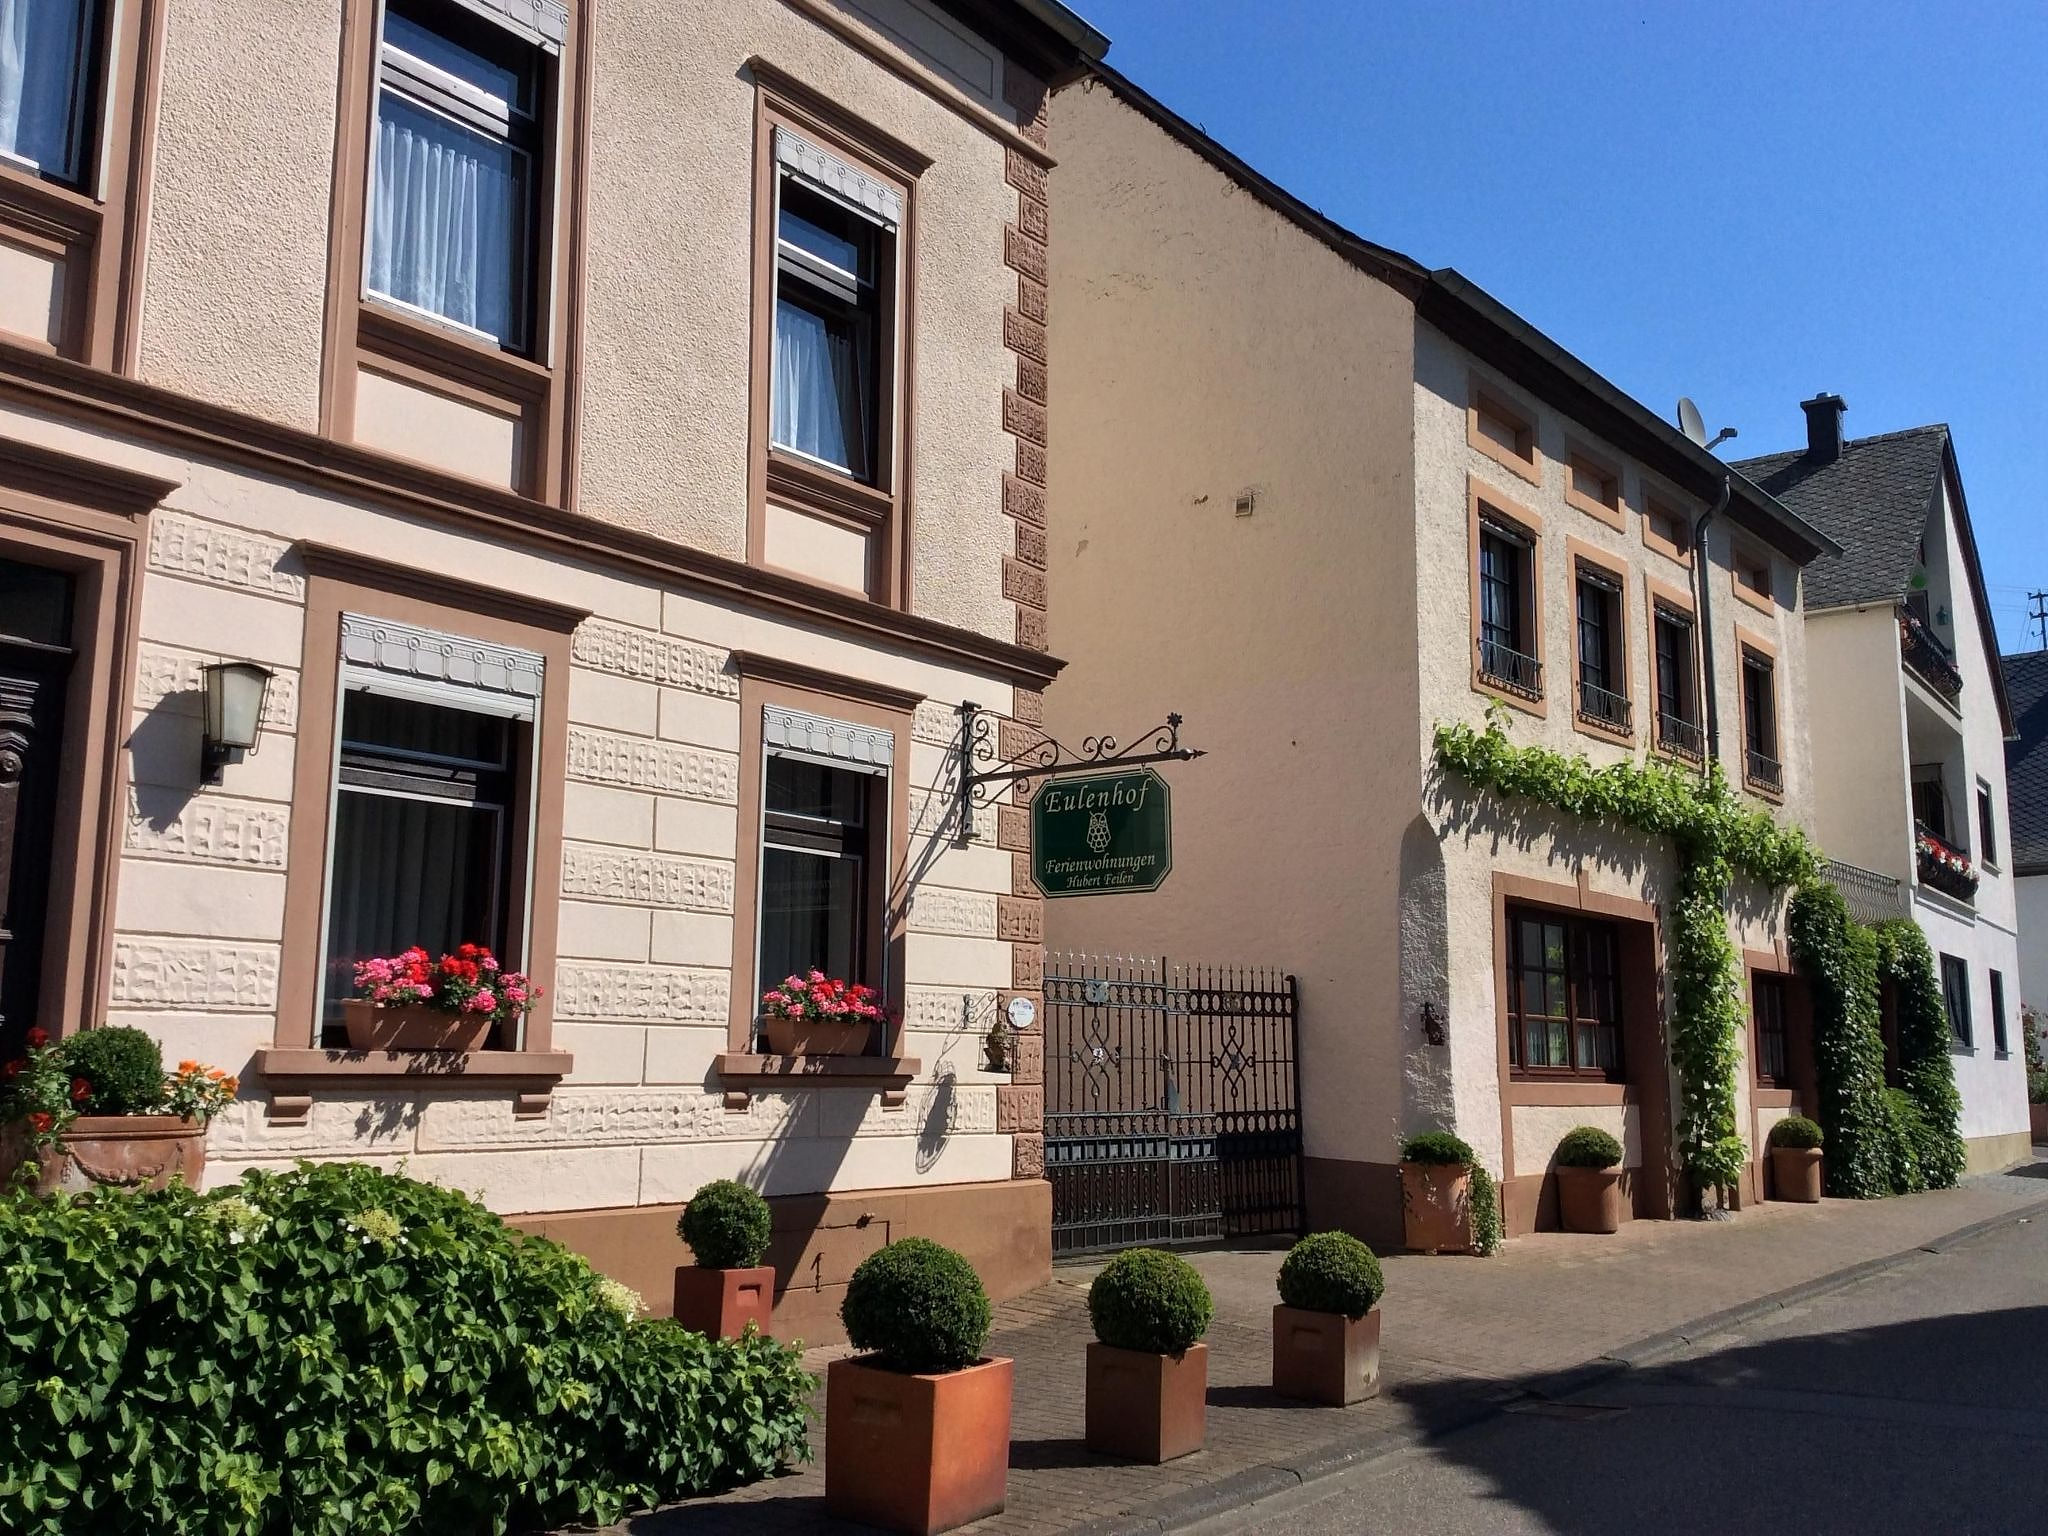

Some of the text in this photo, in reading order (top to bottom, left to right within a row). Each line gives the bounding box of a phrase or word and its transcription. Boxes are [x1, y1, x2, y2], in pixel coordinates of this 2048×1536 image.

[1044, 778, 1152, 813] Eulenhof
[1045, 852, 1156, 874] Ferienwohnungen
[1066, 870, 1135, 888] Hubert Feilen
